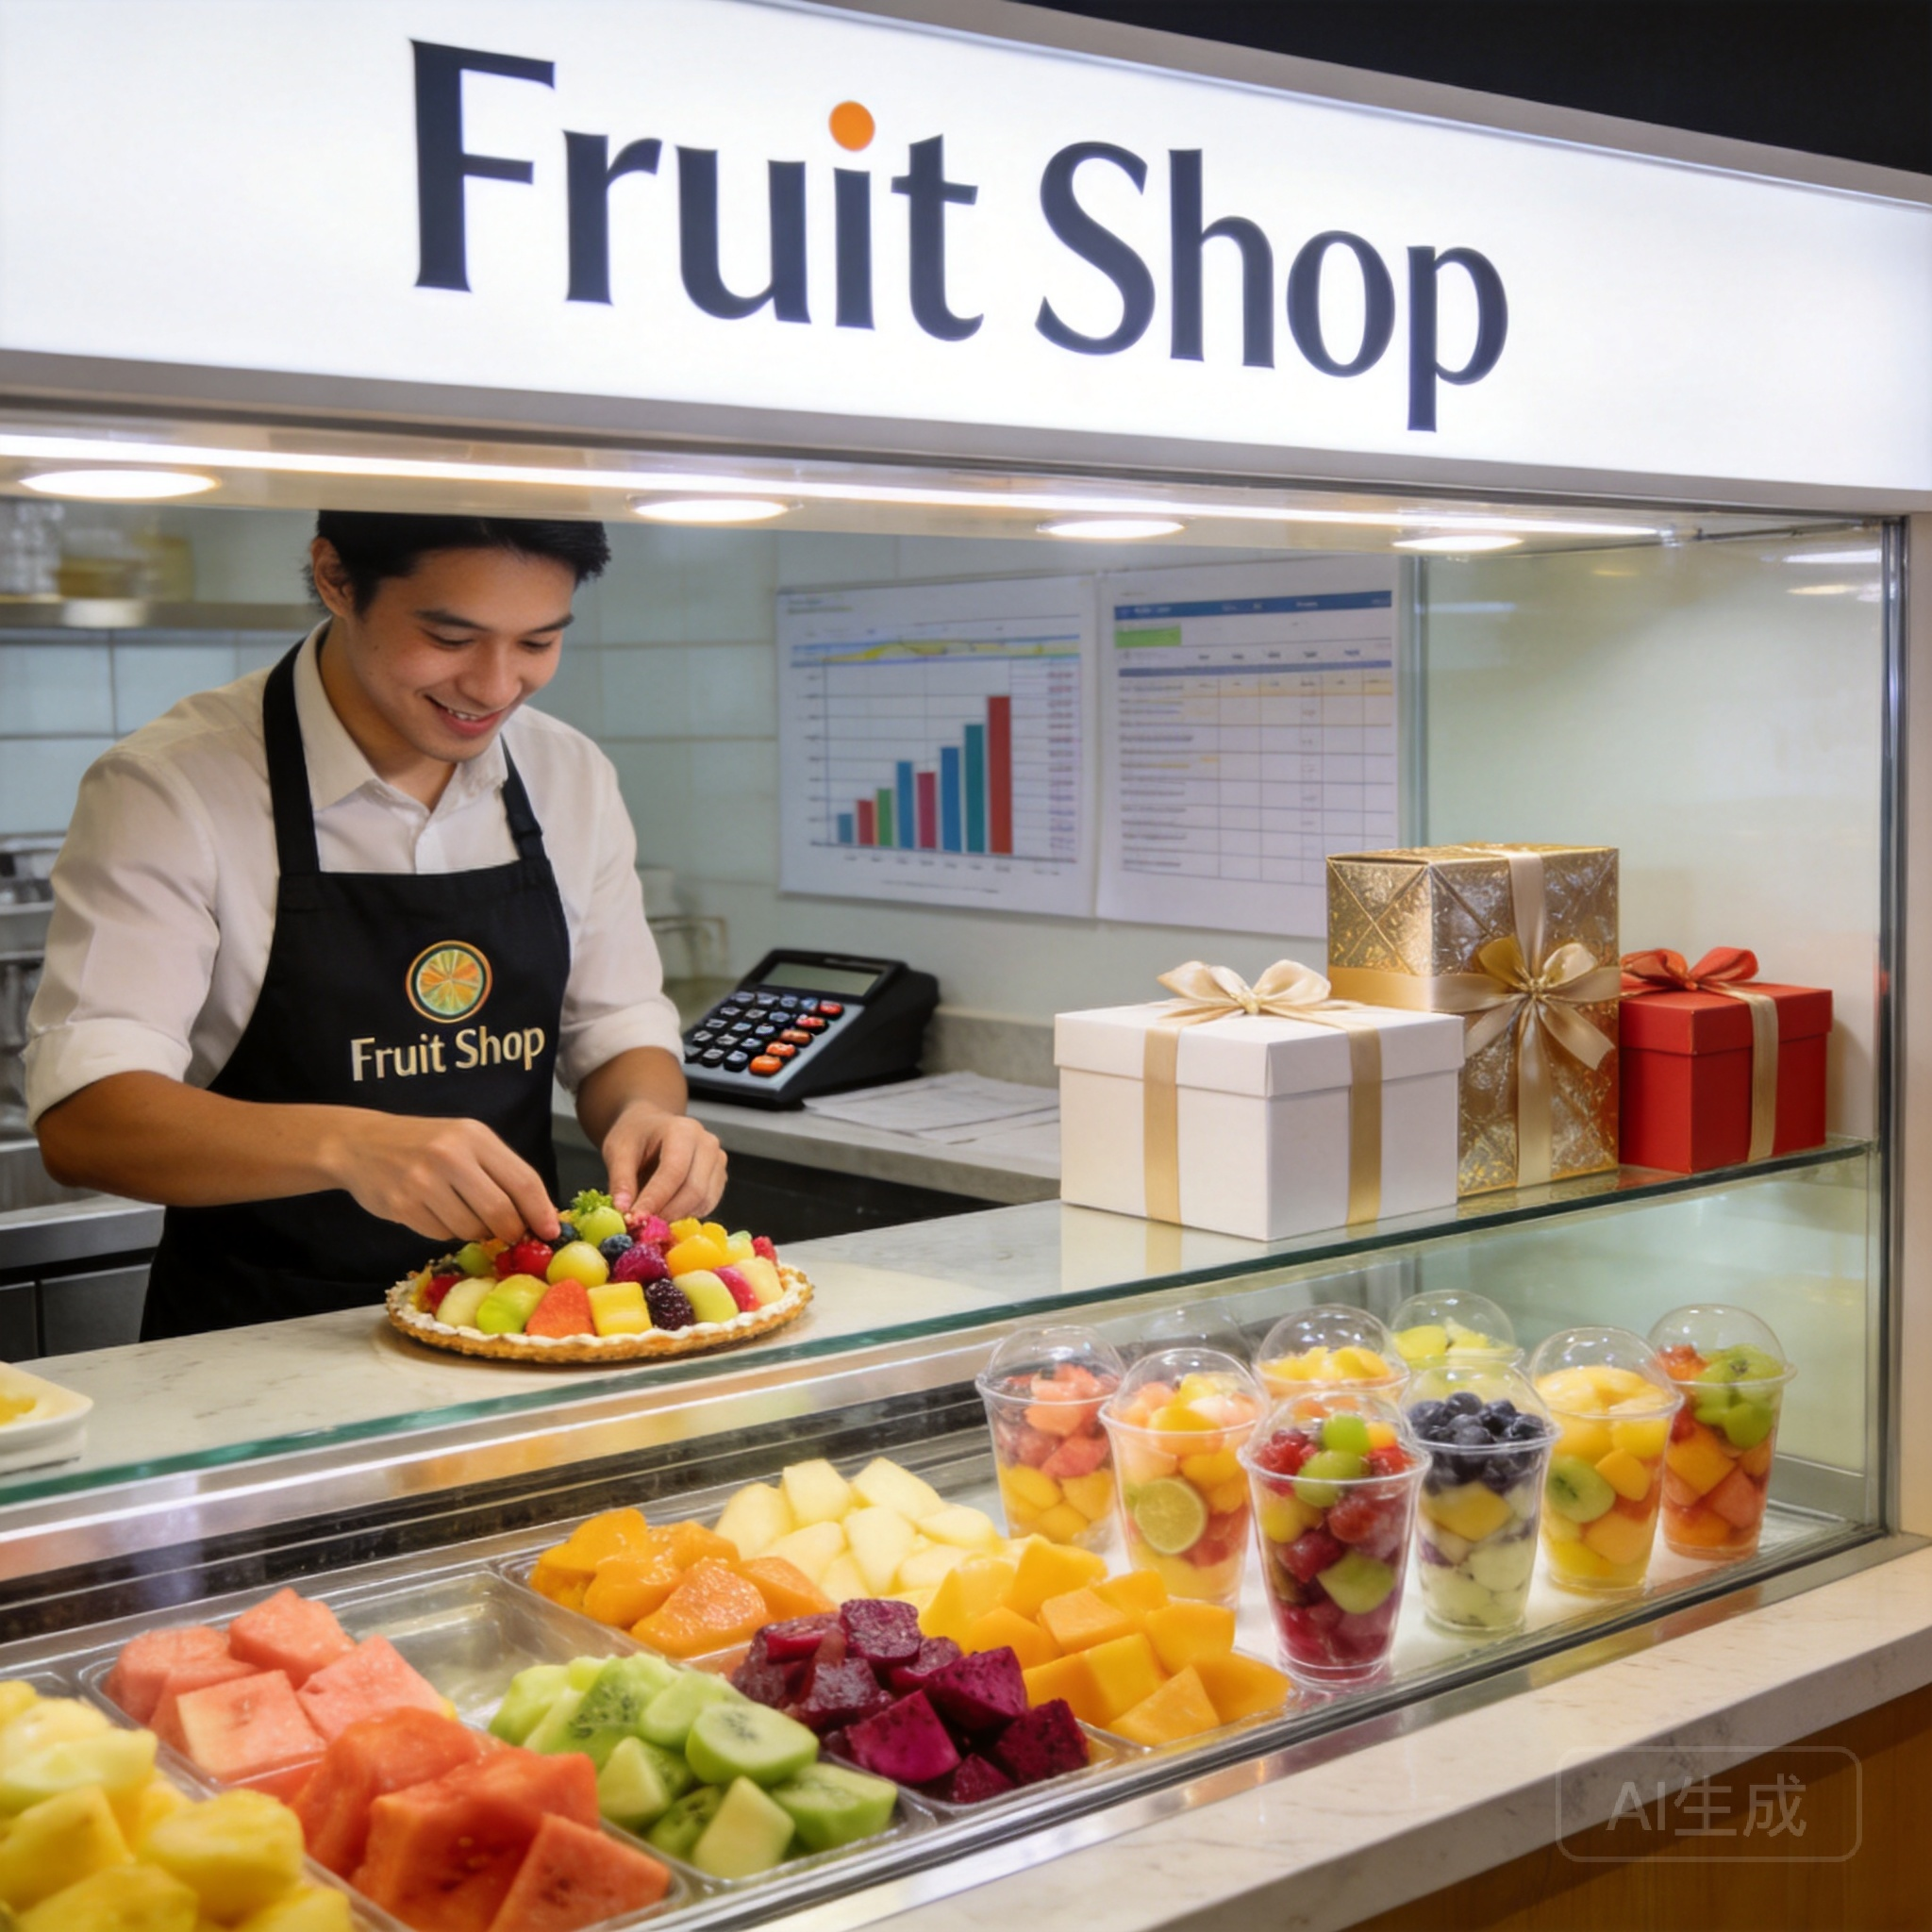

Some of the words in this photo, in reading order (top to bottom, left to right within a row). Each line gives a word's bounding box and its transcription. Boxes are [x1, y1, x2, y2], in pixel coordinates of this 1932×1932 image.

[409, 39, 984, 341] Fruit
[1037, 142, 1508, 432] Shop
[350, 1033, 447, 1082] Fruit
[455, 1025, 546, 1072] Shop
